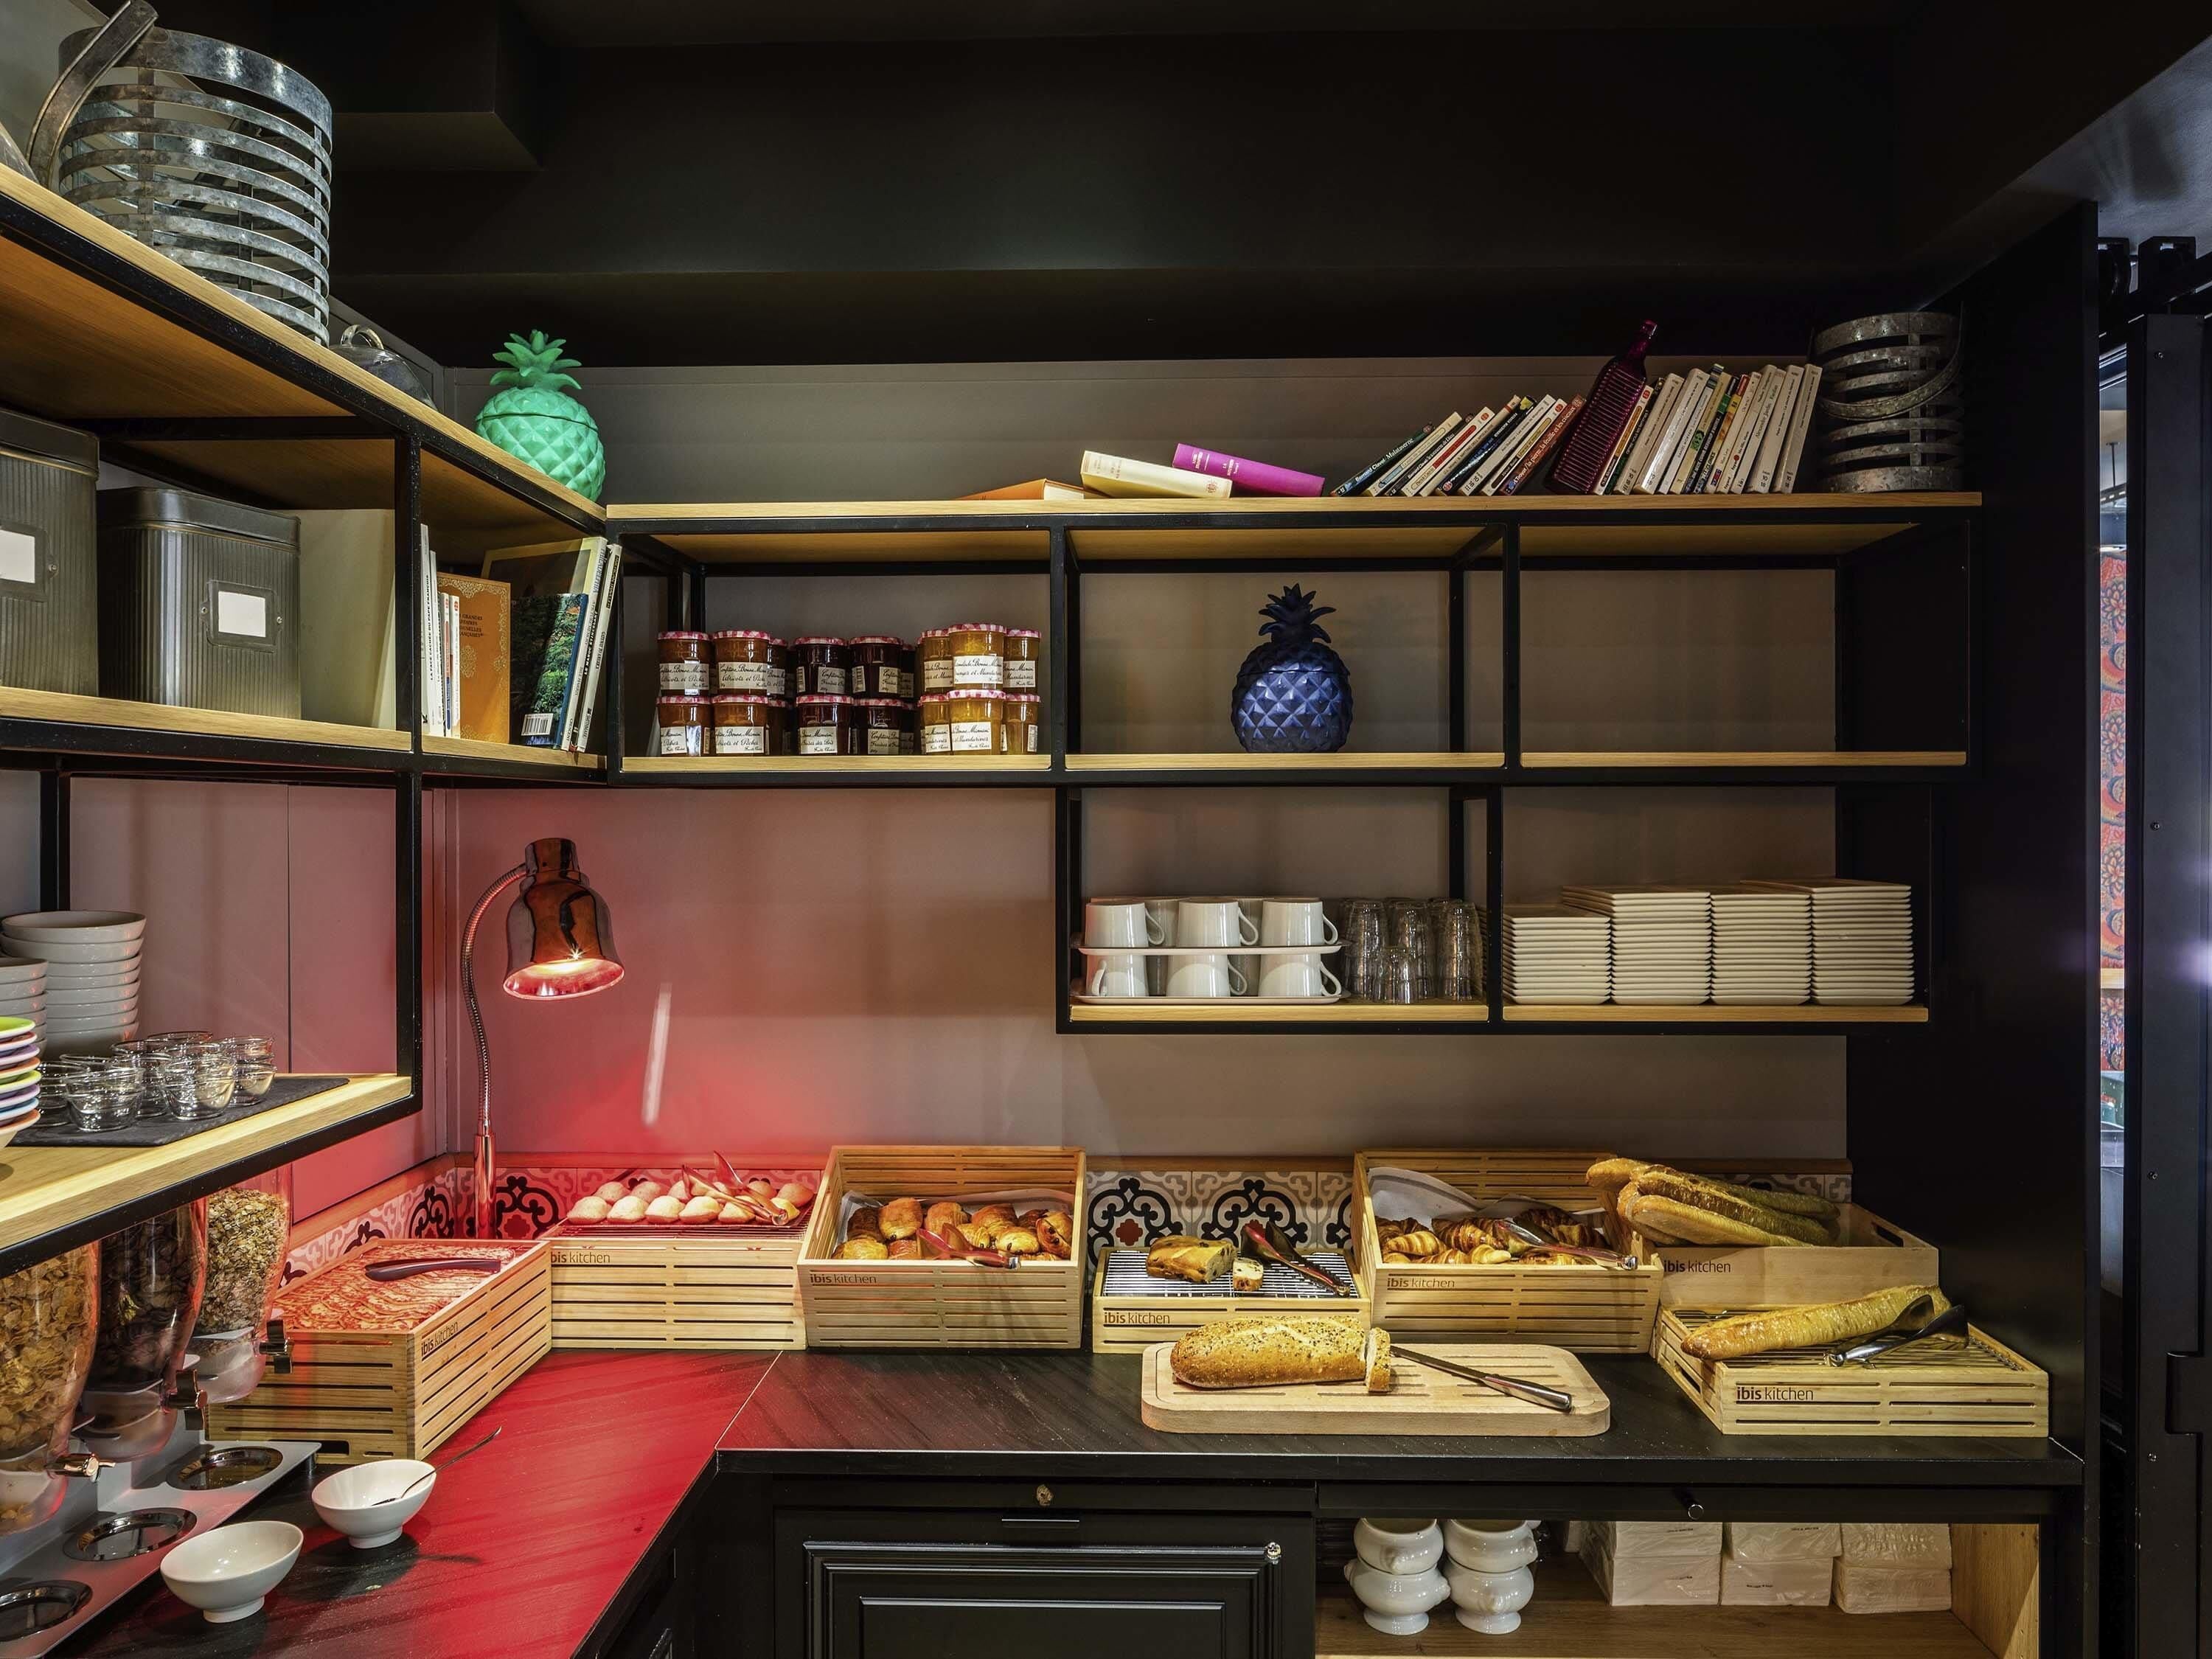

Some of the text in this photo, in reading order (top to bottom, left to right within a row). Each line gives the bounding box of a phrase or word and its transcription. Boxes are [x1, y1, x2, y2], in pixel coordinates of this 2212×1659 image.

[1763, 402, 1772, 416] Jardin
[1354, 467, 1373, 482] Bernard
[1371, 457, 1386, 470] Clavel
[1385, 437, 1414, 460] Malataverne
[739, 663, 754, 672] Bonne
[973, 658, 988, 667] Bonne
[566, 717, 574, 740] CRESCENT
[726, 728, 742, 737] Bonne
[970, 725, 990, 734] Maman
[551, 1251, 611, 1263] bis kitchen
[1663, 1260, 1731, 1273] ibis kitchen
[810, 1273, 877, 1284] ibis kitchen
[1387, 1277, 1455, 1287] ibis kitchen
[1104, 1312, 1171, 1324] ibis kitchen
[421, 1321, 458, 1357] ibis kitchen
[1736, 1386, 1814, 1401] ibis kitchen
